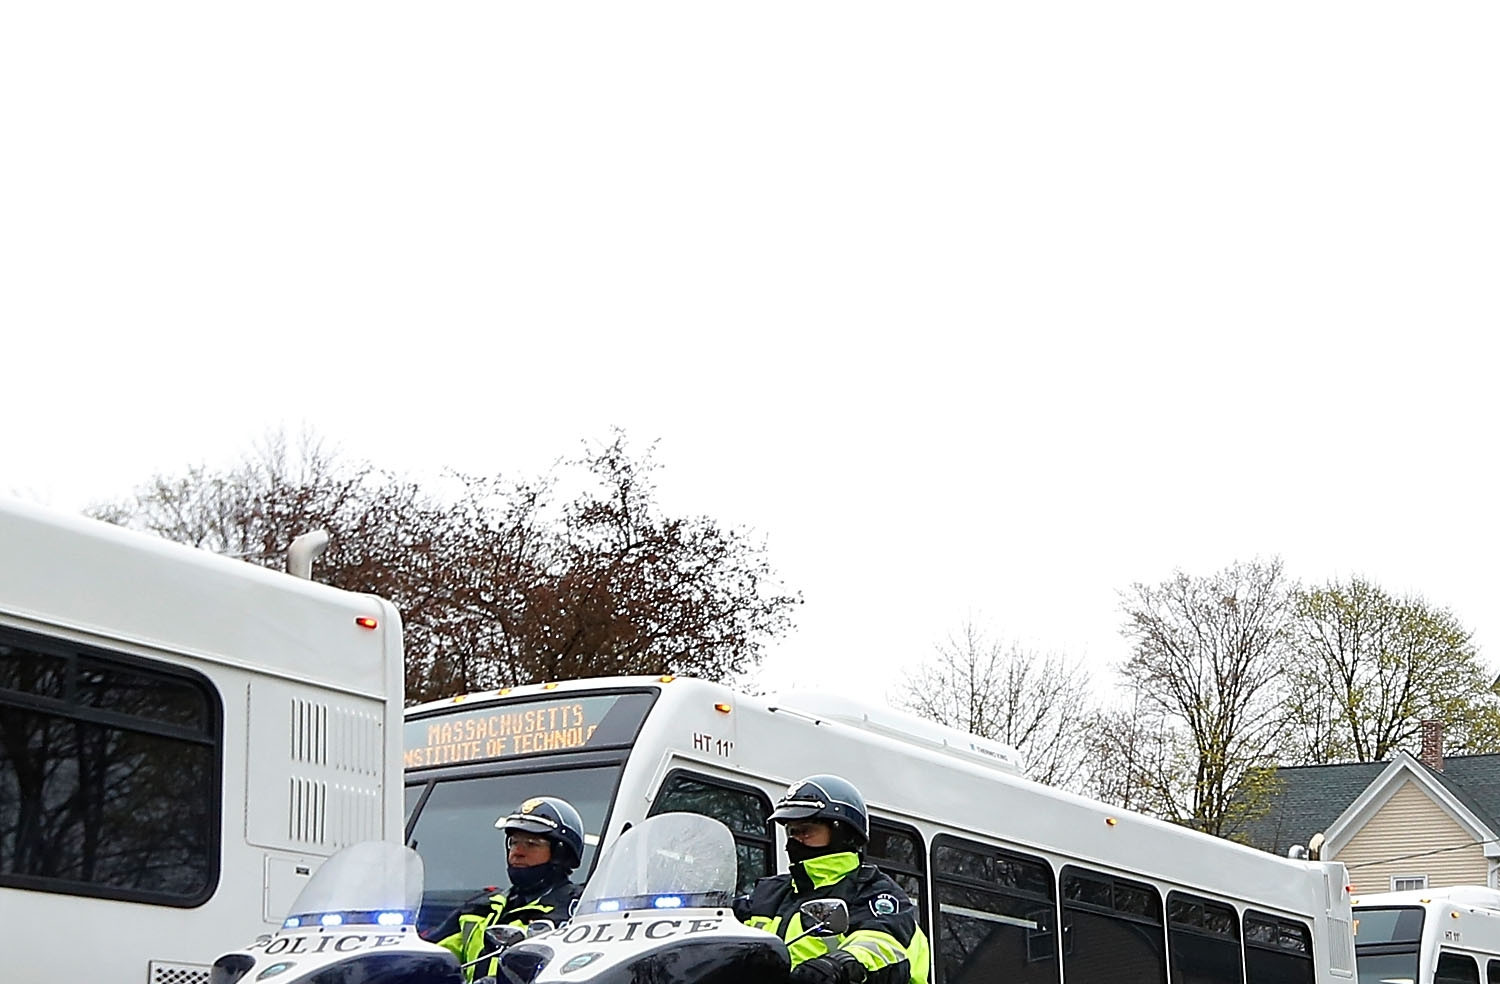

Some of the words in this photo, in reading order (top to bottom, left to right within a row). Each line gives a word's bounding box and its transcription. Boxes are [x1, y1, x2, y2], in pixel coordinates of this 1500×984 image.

[427, 704, 584, 746] MASSACHUSETTS
[403, 740, 482, 768] NSTITUTE
[486, 737, 507, 758] OF
[693, 732, 712, 752] HT
[540, 919, 723, 944] POLICE
[246, 934, 405, 955] POLICE
